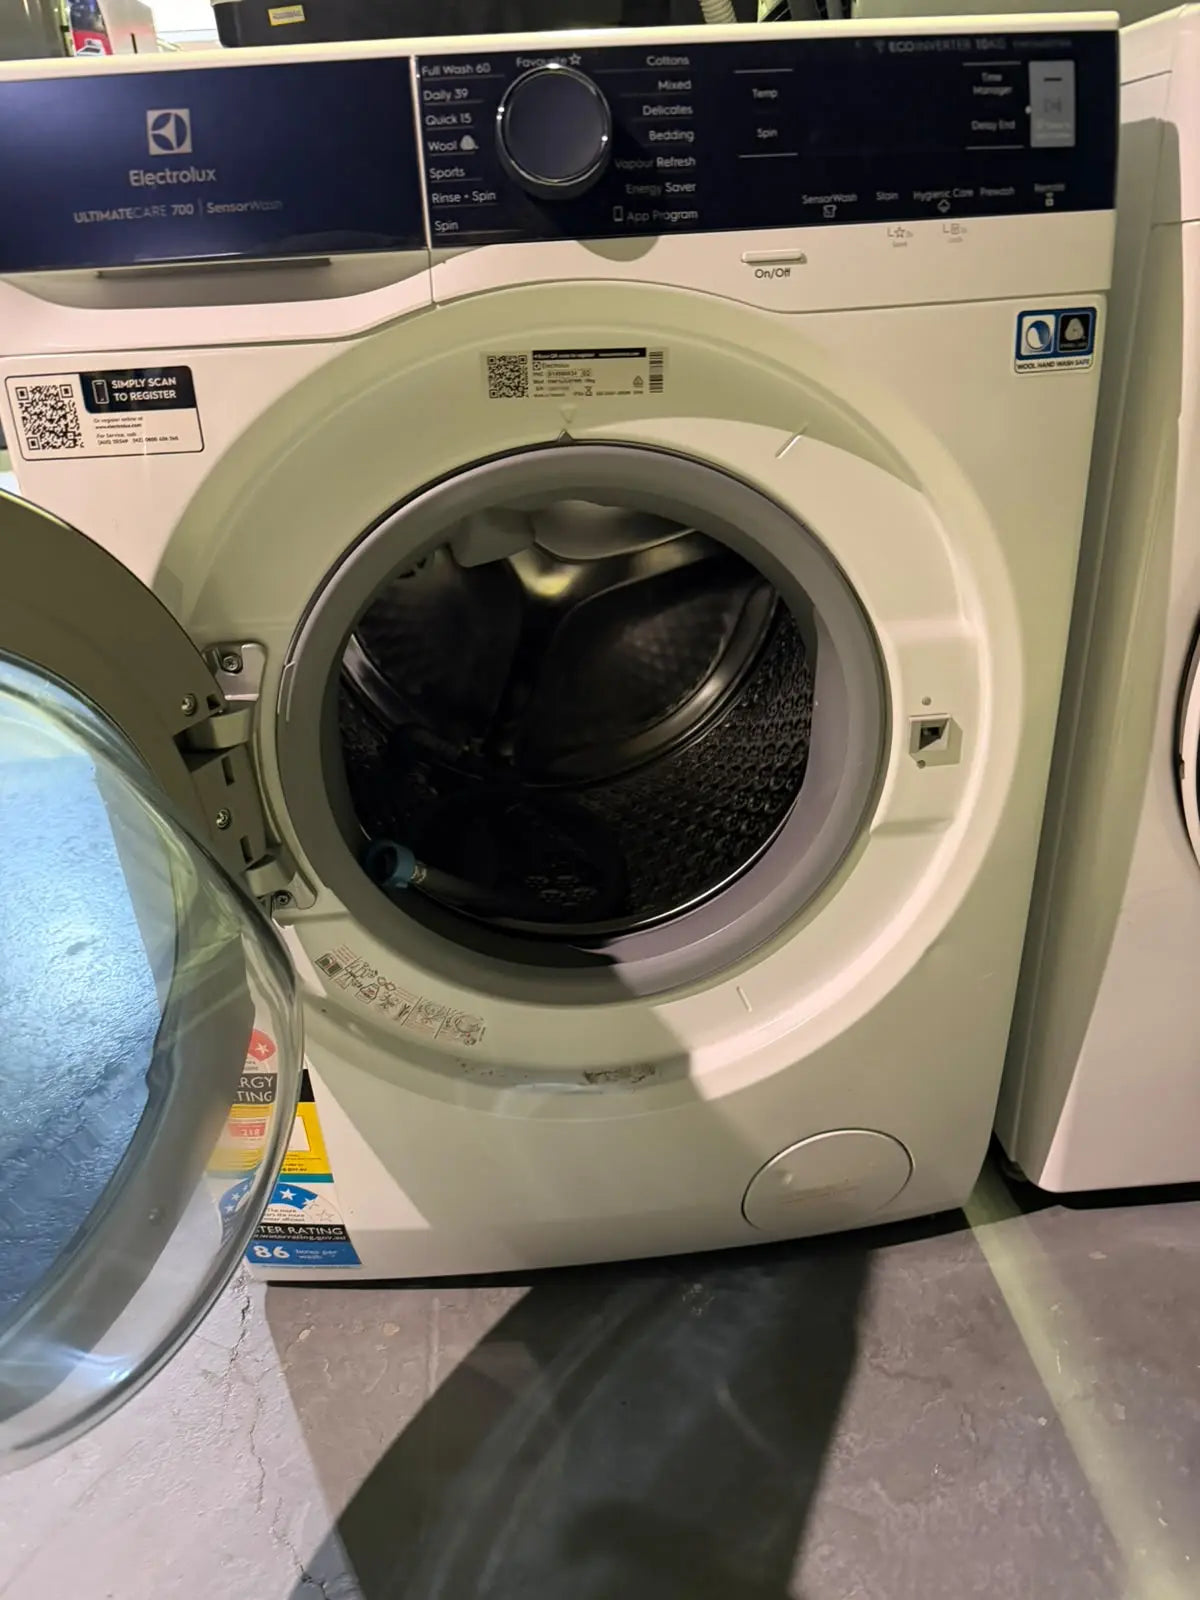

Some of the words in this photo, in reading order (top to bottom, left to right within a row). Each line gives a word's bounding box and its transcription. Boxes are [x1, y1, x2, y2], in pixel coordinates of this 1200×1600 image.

[646, 55, 690, 66] Cottons
[421, 65, 441, 76] Full
[443, 64, 474, 75] Wash
[475, 62, 491, 74] 60
[658, 79, 692, 91] Mixed
[423, 89, 452, 102] Daily
[453, 87, 469, 99] 39
[752, 88, 778, 101] Temp
[643, 104, 693, 117] Delicates
[425, 114, 458, 127] Quick
[459, 113, 472, 125] 15
[648, 130, 694, 142] Bedding
[757, 128, 778, 140] Spin
[427, 141, 458, 152] Wool
[656, 156, 697, 168] Refresh
[128, 166, 217, 188] Electrolux
[429, 166, 466, 180] Sports
[664, 182, 697, 194] Saver
[431, 192, 462, 204] Rinse
[471, 190, 497, 203] Spin
[73, 204, 167, 223] ULTIMATECARE
[171, 204, 195, 217] 700
[206, 199, 283, 214] SensorWash
[626, 211, 651, 225] App
[652, 208, 699, 222] Program
[434, 220, 460, 233] Spin
[754, 267, 793, 281] On/Off
[111, 378, 147, 390] SIMPLY
[148, 376, 177, 388] SCAN
[113, 391, 128, 402] TO
[130, 390, 177, 401] REGISTER
[257, 1225, 285, 1235] TER
[287, 1226, 344, 1236] RATING
[252, 1245, 291, 1260] 86
